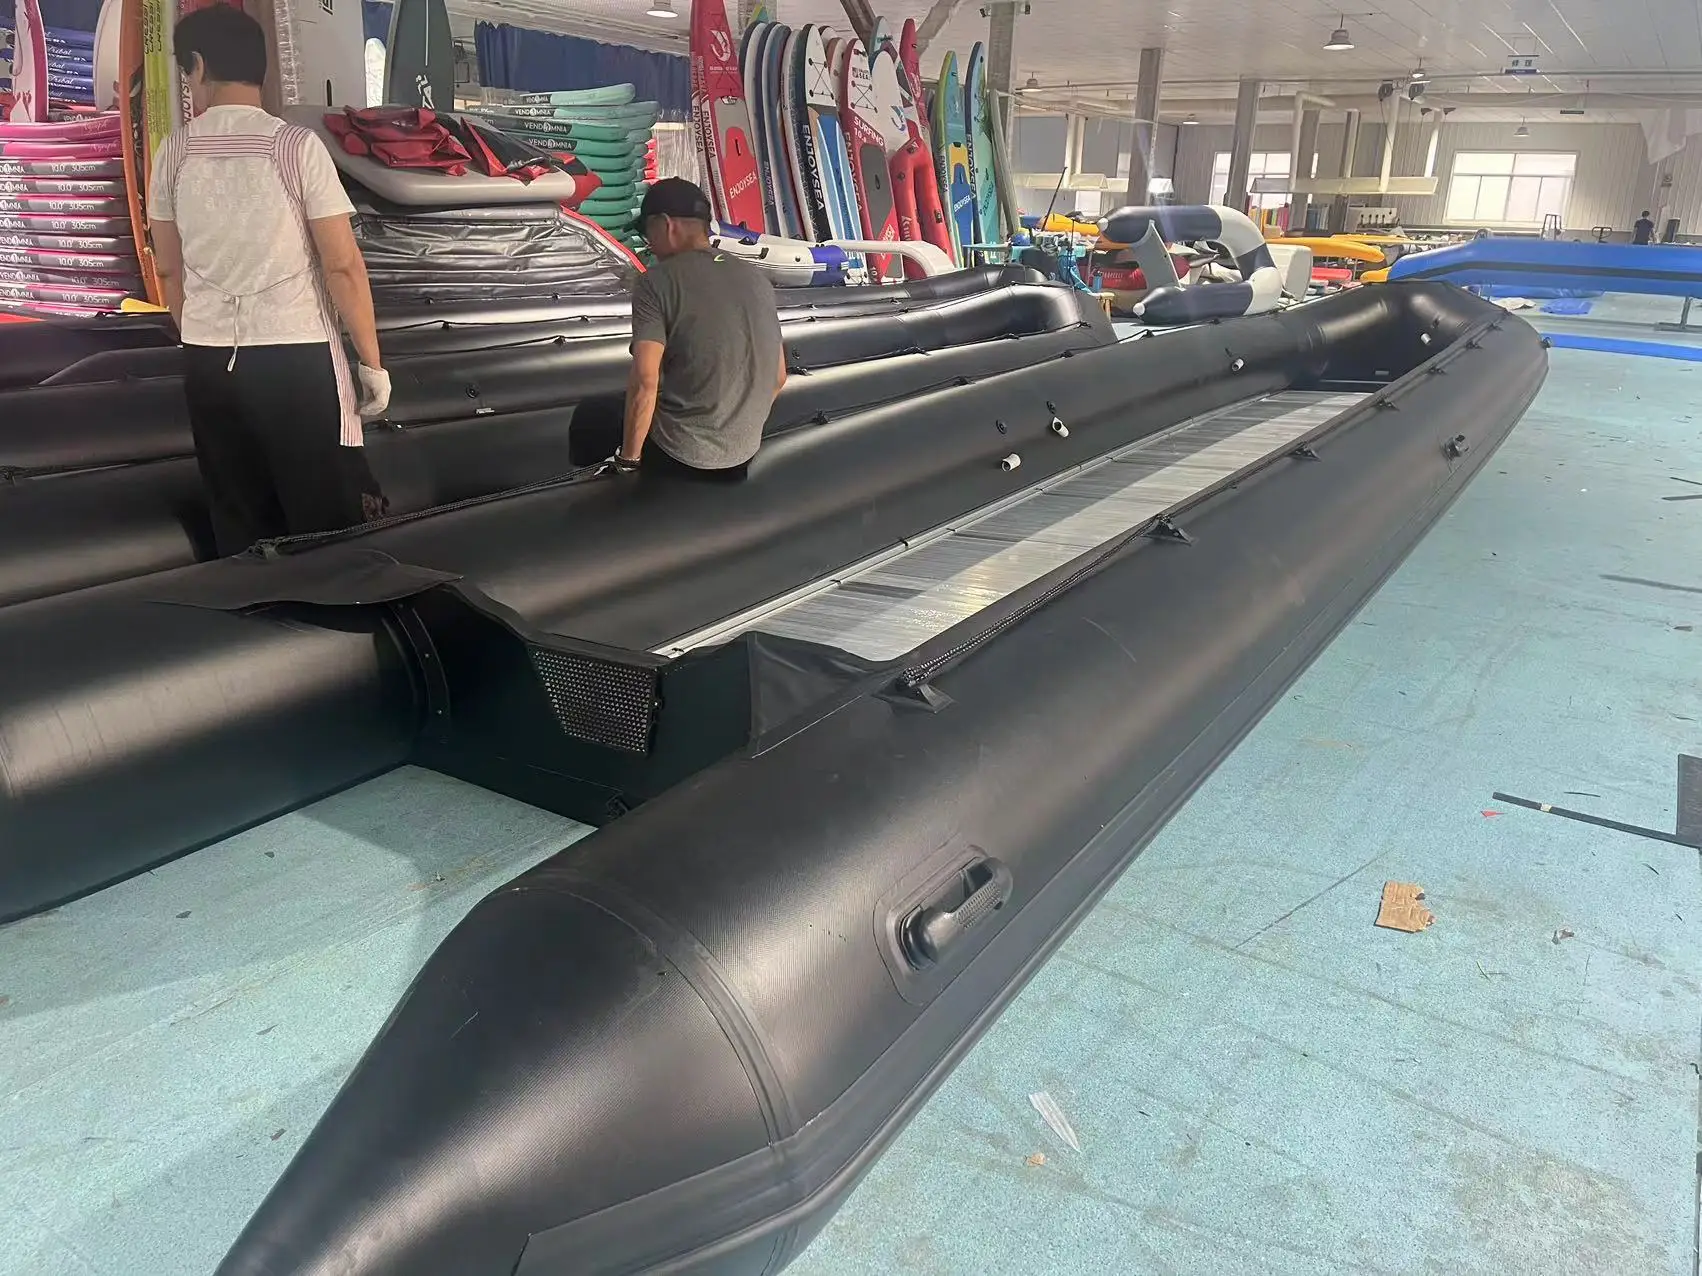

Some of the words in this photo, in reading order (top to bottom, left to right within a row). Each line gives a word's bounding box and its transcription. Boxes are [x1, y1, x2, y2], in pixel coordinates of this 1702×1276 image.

[514, 107, 552, 116] VENDOMNIA
[524, 121, 568, 134] VENDOMNIA
[853, 116, 884, 147] SURFING
[528, 138, 573, 150] VENDOMNIA
[802, 124, 826, 212] ENJOYSEA
[729, 170, 758, 199] ENJOYSEA
[69, 202, 94, 211] 305cm
[72, 222, 96, 230] 305cm
[78, 240, 103, 249] 305cm
[79, 258, 104, 268] 305cm
[83, 294, 110, 304] 305cm
